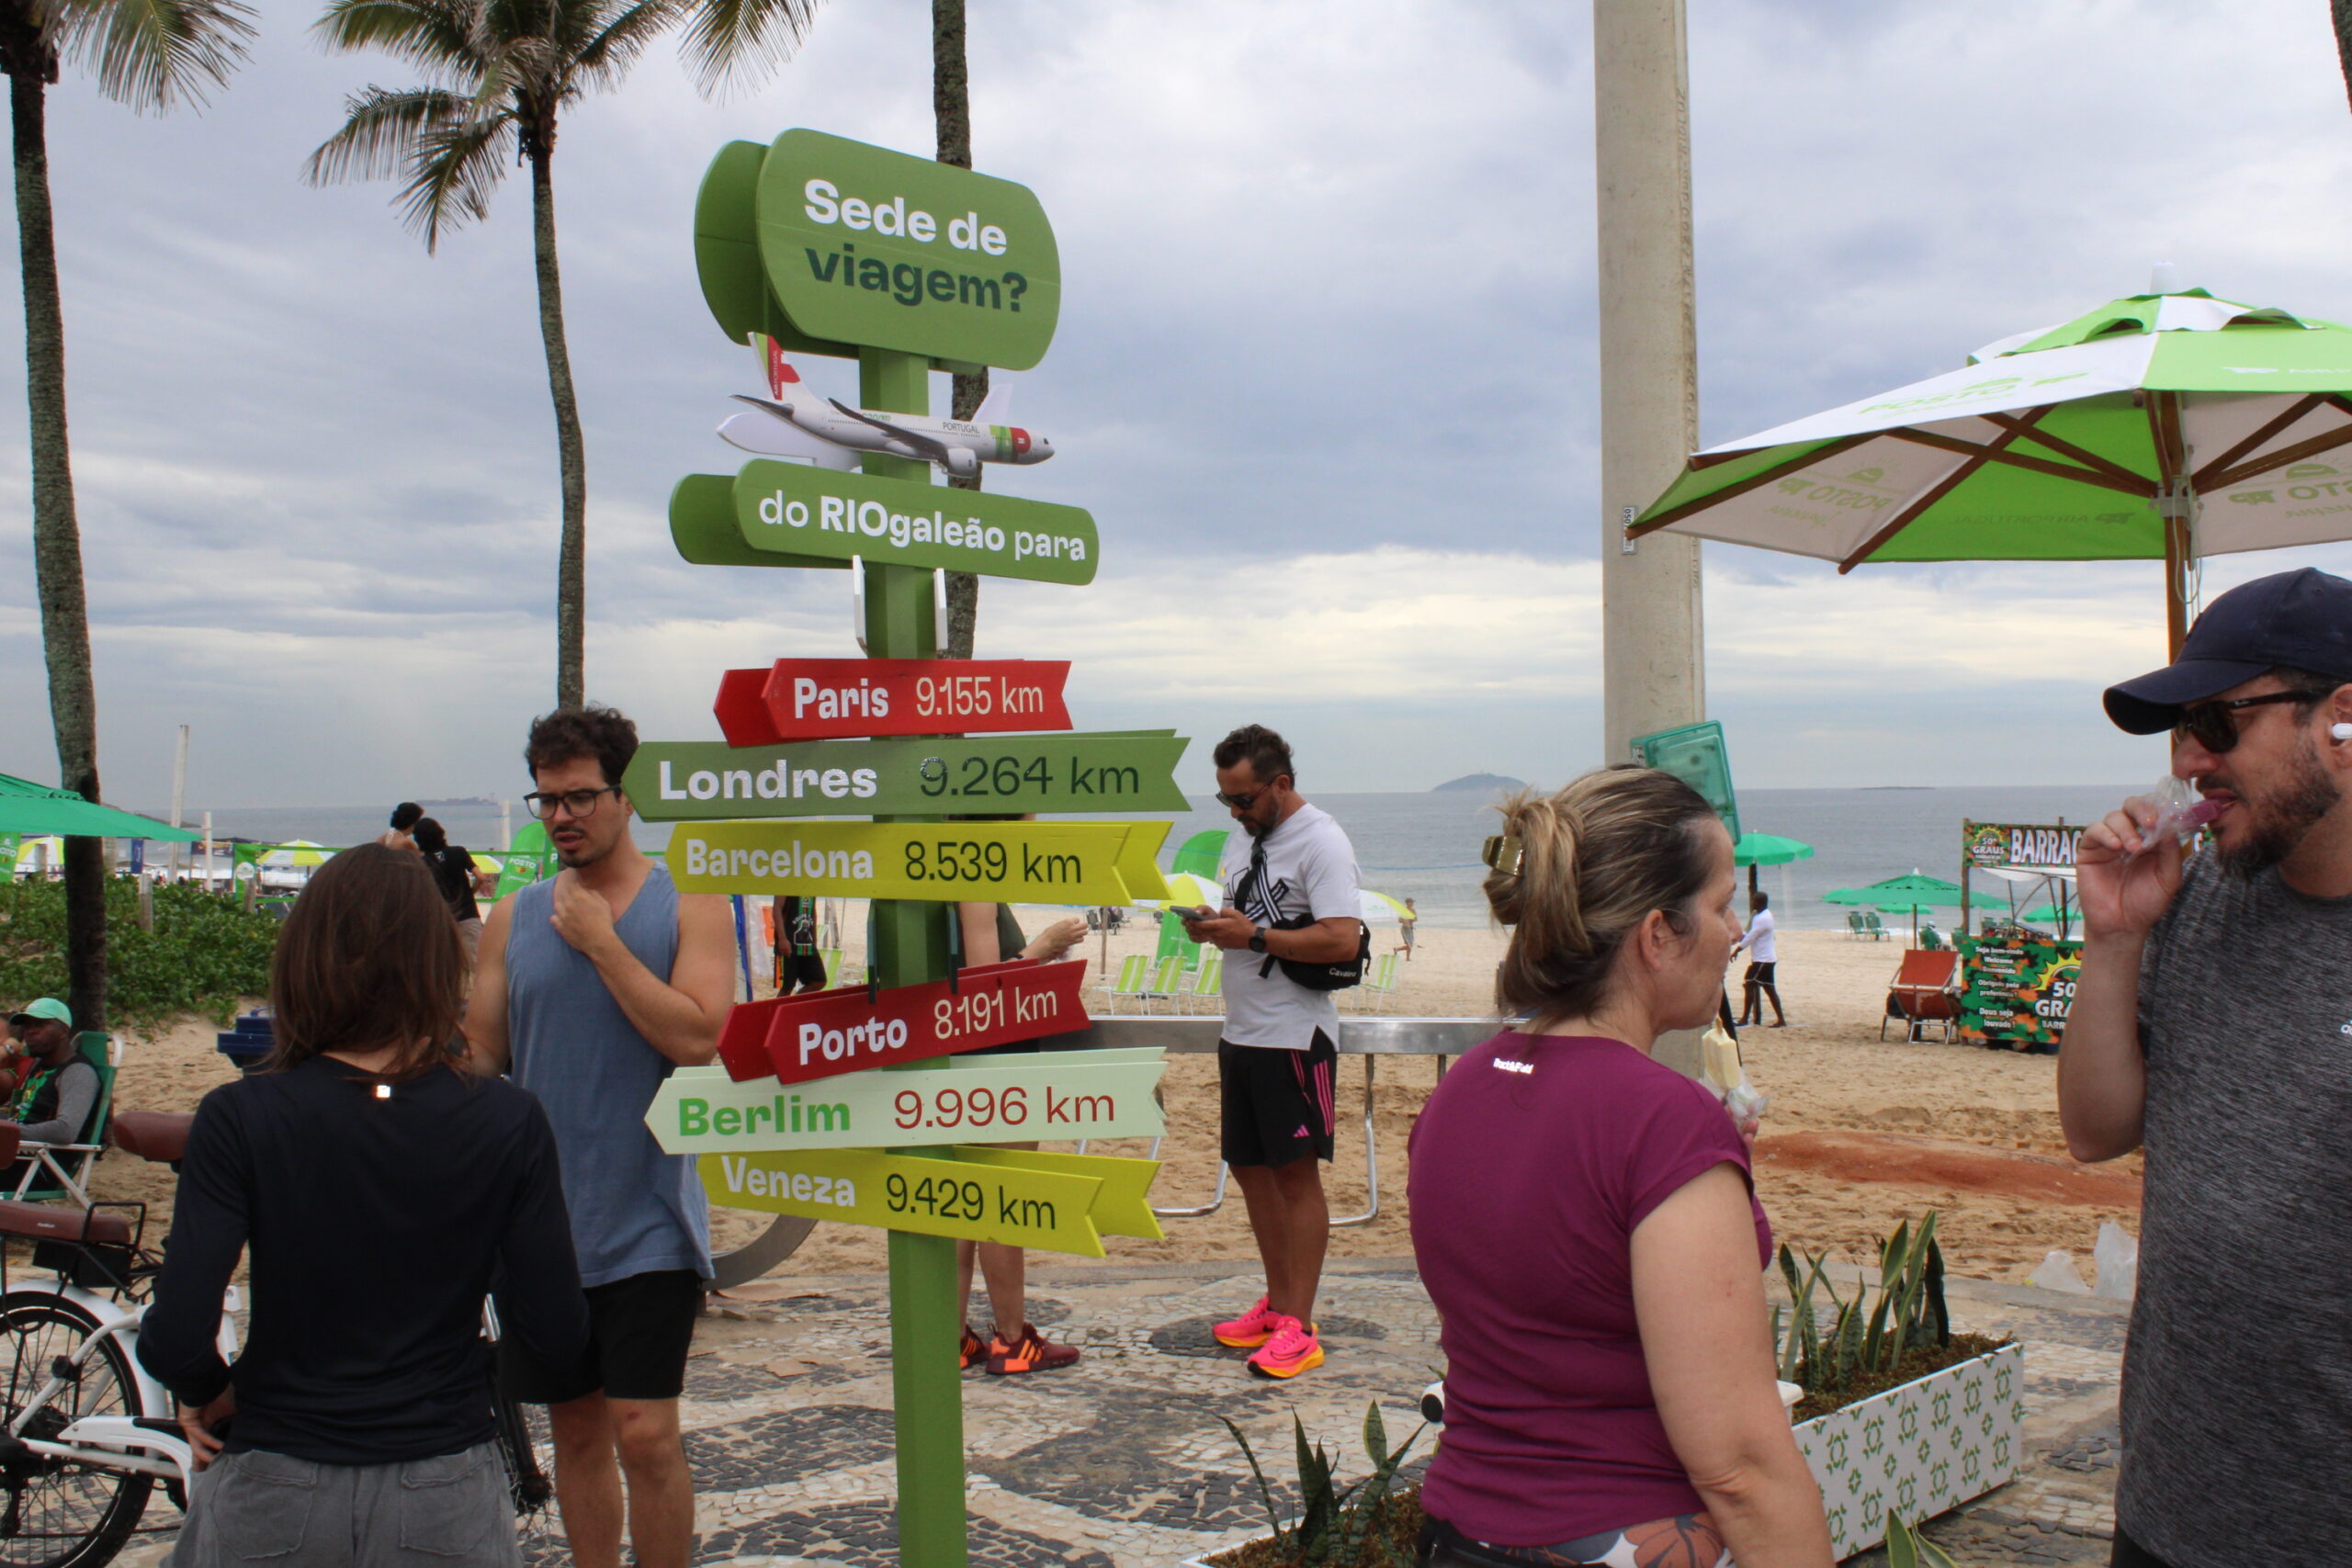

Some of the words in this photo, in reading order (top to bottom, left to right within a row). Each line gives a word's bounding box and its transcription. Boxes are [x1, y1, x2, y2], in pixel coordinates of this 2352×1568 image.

[804, 178, 937, 243] Sede
[947, 210, 1008, 256] de
[805, 243, 1028, 313] viagem?
[942, 422, 980, 434] PORTUGAL
[758, 489, 809, 529] do
[820, 494, 1006, 549] RIOgaleão
[1014, 529, 1087, 563] para
[794, 677, 889, 719] Paris
[915, 676, 992, 717] 9.155
[1001, 676, 1045, 715] km
[660, 759, 877, 801] Londres
[920, 756, 1054, 797] 9.264
[1070, 756, 1140, 795] km
[686, 838, 874, 880] Barcelona
[905, 840, 1008, 882] 8.539
[1023, 842, 1081, 884] km
[1973, 845, 2004, 854] GRAUS
[2010, 829, 2082, 863] BARRAC
[2053, 982, 2075, 997] 50
[798, 1016, 909, 1066] Porto
[933, 989, 1005, 1041] 8.191
[1015, 986, 1058, 1023] km
[2041, 1021, 2065, 1029] BARR
[679, 1094, 851, 1137] Berlim
[893, 1086, 1029, 1131] 9.996
[1046, 1086, 1115, 1124] km
[721, 1154, 856, 1208] Veneza
[886, 1173, 985, 1222] 9.429
[999, 1184, 1057, 1230] km
